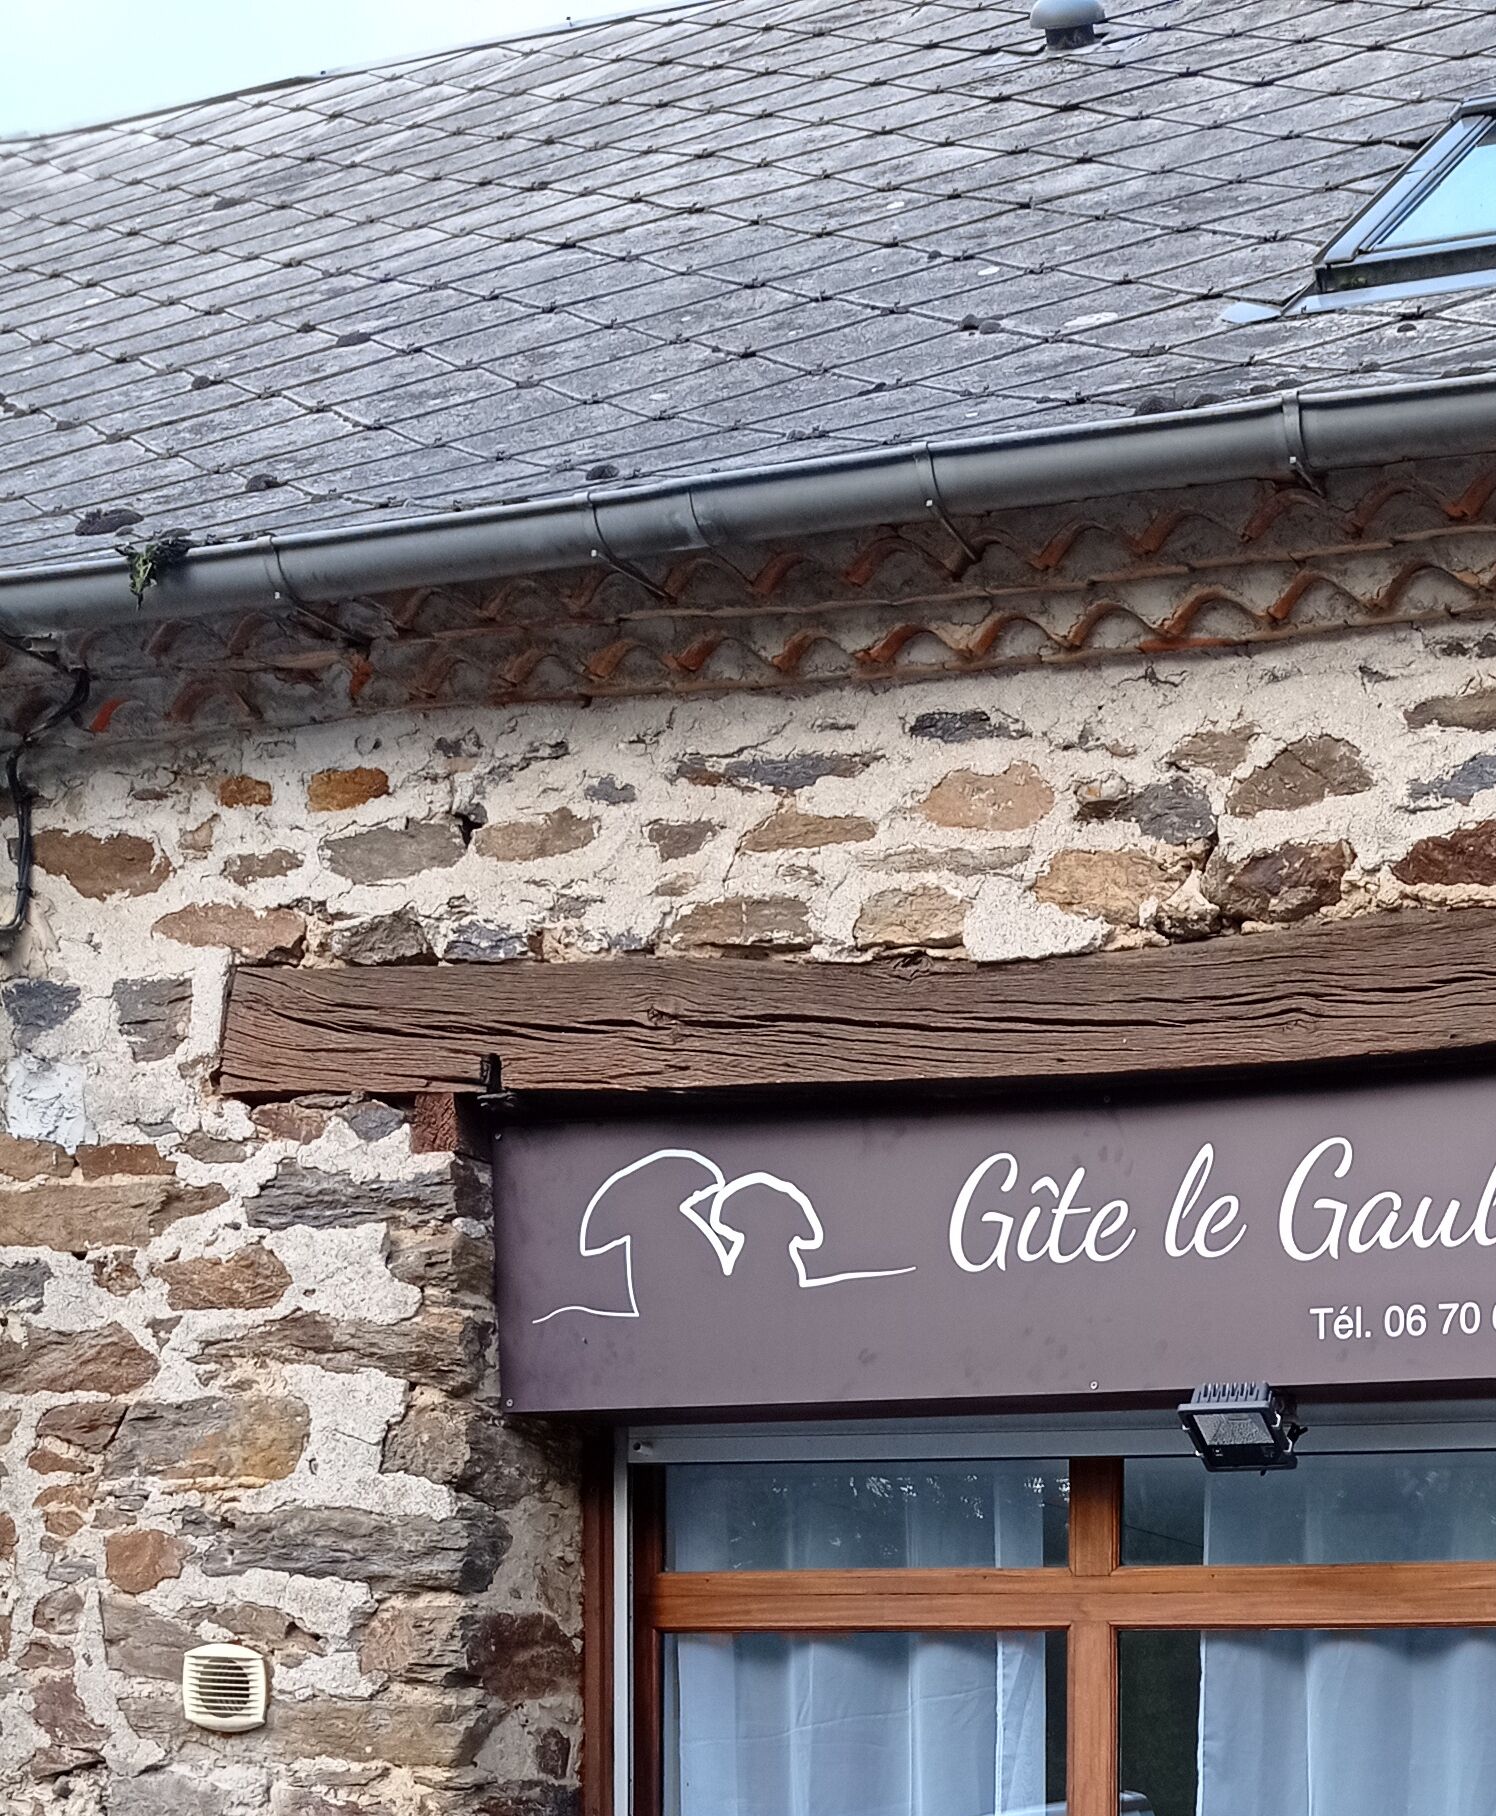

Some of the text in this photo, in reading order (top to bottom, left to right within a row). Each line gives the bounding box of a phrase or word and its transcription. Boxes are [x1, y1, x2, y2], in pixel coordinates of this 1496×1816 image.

[949, 1152, 1137, 1273] Gîte
[1164, 1142, 1247, 1258] le
[1309, 1305, 1372, 1340] Tél.
[1384, 1304, 1427, 1338] 06
[1438, 1301, 1481, 1335] 70
